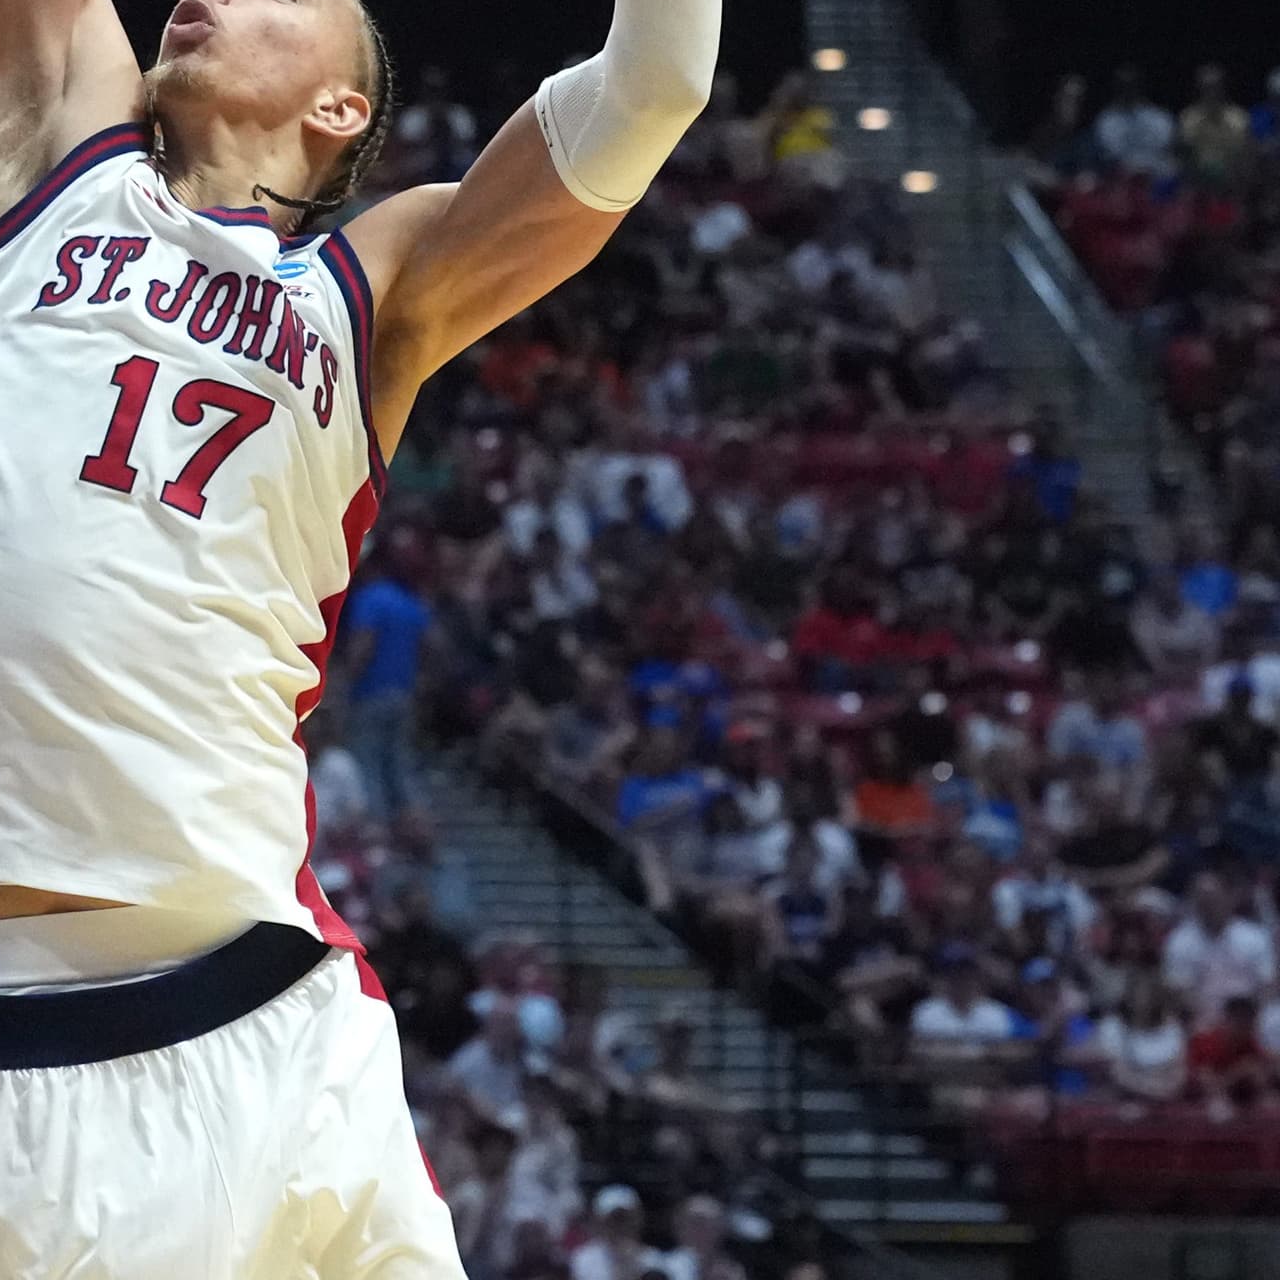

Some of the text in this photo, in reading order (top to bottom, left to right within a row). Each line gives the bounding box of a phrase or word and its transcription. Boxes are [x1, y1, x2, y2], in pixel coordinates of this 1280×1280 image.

[31, 235, 338, 429] ST. JOHN'S
[79, 354, 275, 520] 17
